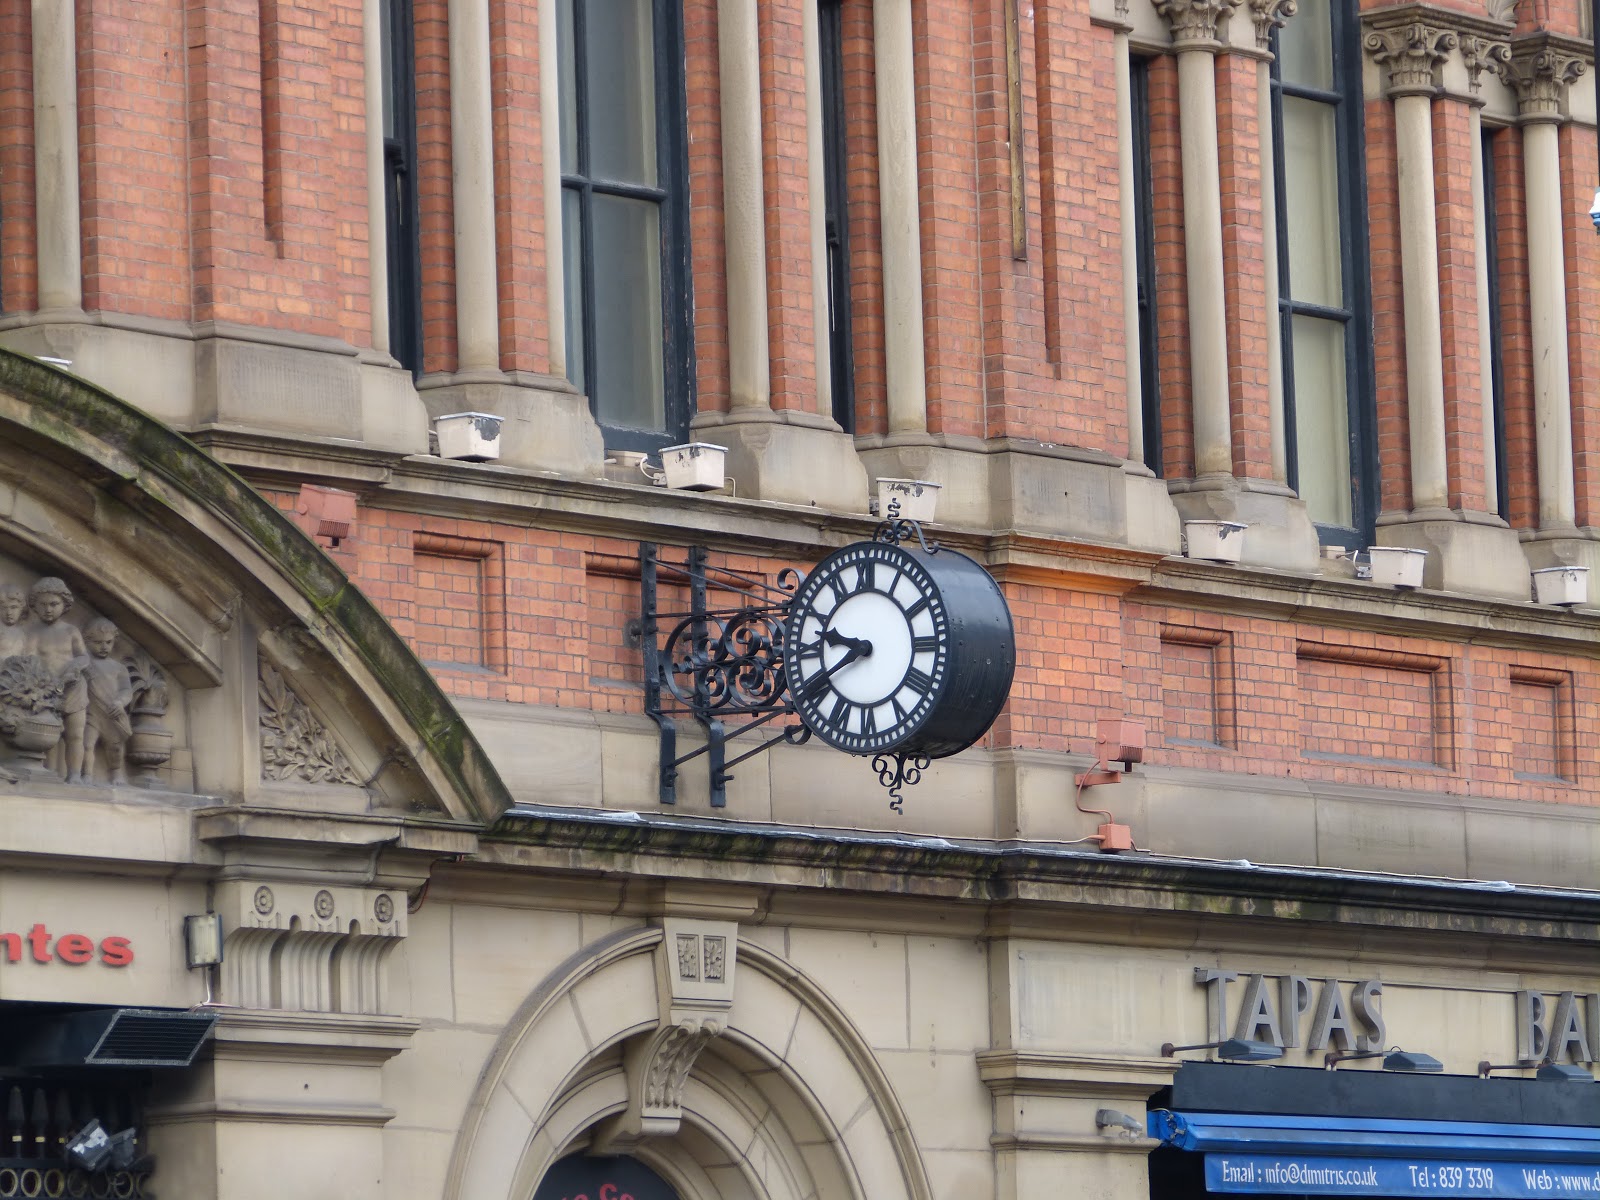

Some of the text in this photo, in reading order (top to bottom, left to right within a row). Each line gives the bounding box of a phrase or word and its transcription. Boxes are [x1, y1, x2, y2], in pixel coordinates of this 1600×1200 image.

[856, 561, 875, 592] XII
[914, 636, 936, 652] III
[1195, 968, 1600, 1062] TAPAS BA
[1265, 1163, 1379, 1186] info@dimitris.co.uk
[1438, 1166, 1463, 1189] 839
[1465, 1167, 1494, 1189] 3319
